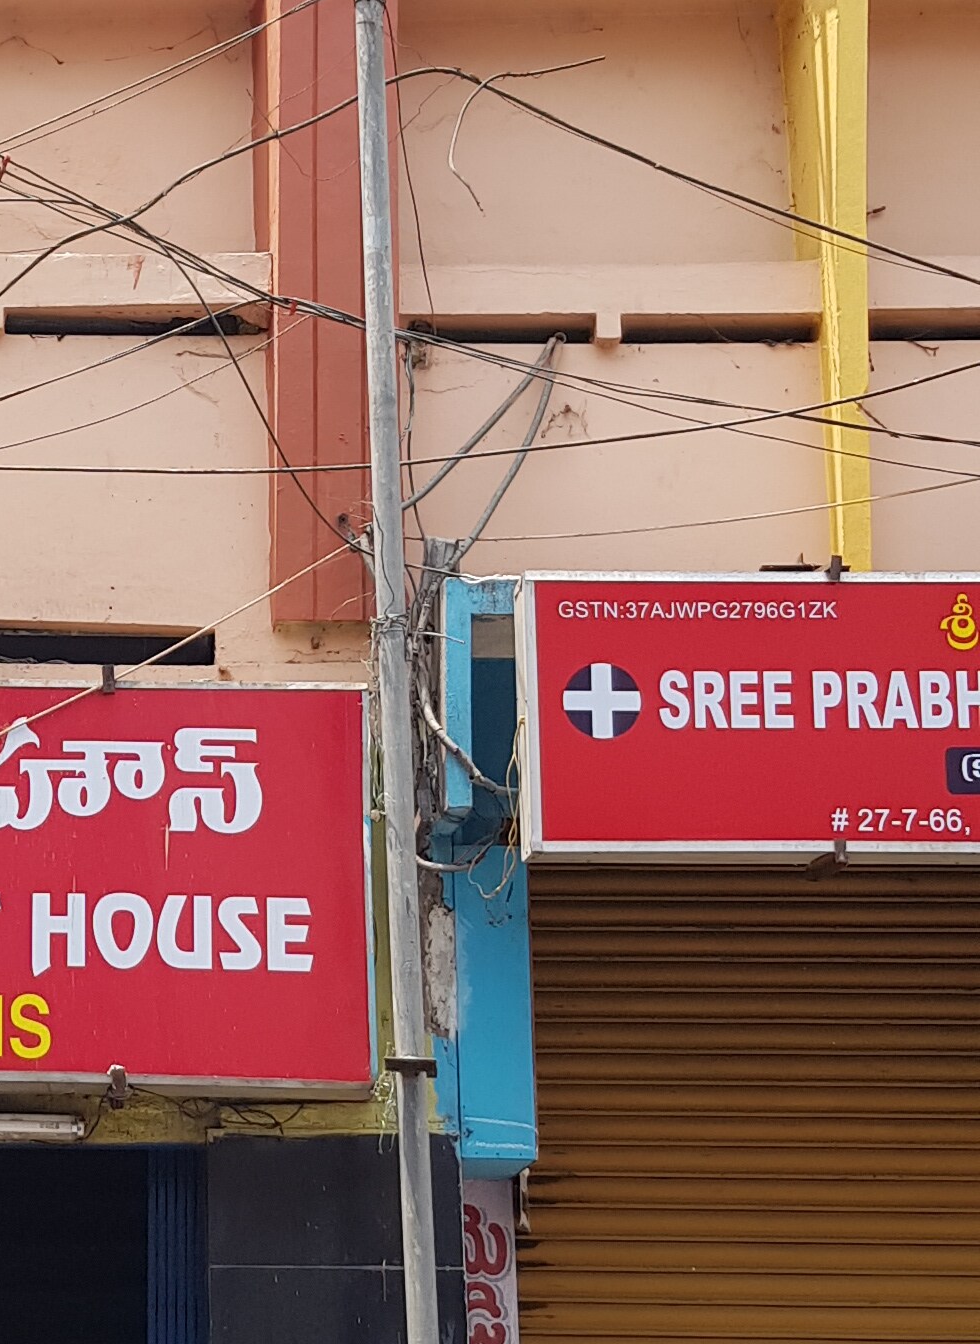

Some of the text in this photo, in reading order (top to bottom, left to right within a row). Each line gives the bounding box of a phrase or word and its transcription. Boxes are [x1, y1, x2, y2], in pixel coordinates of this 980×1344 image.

[558, 601, 838, 620] GSTN:37AJWPG2796G1ZK
[658, 669, 795, 730] SREE
[858, 808, 971, 836] 27-7-66,
[31, 892, 314, 977] HOUSE
